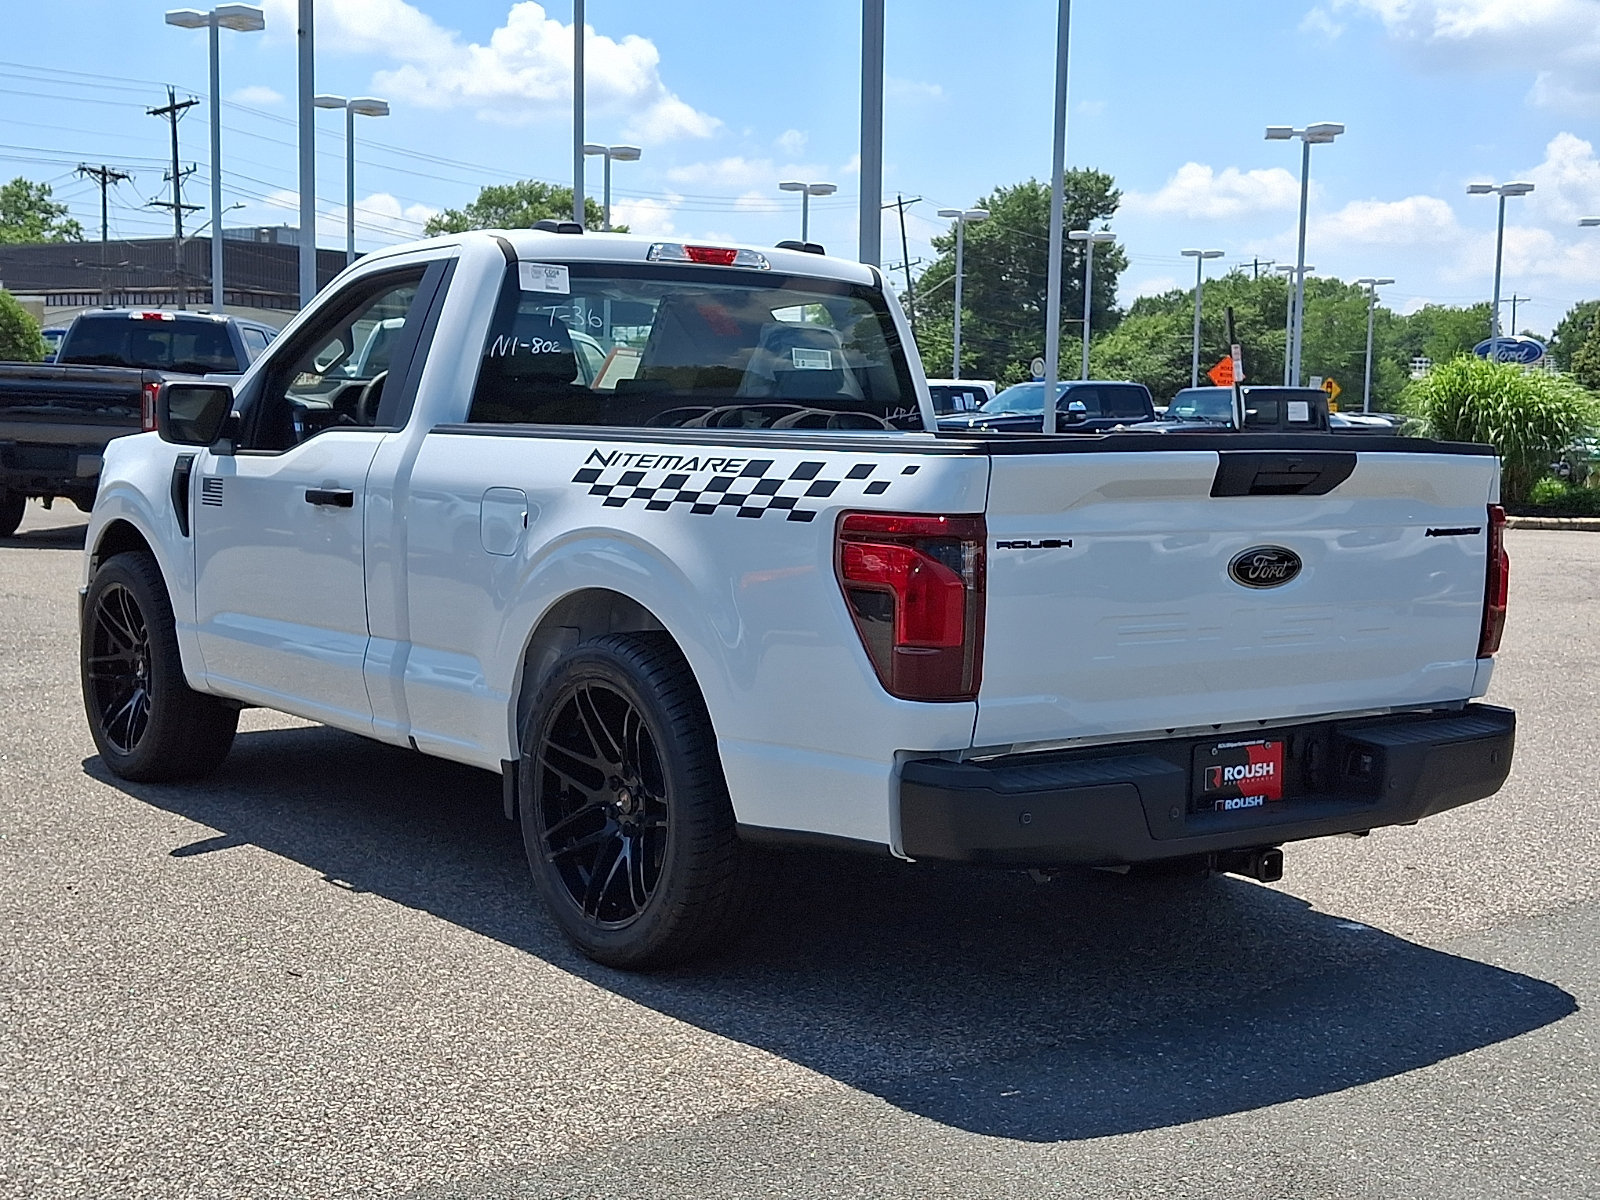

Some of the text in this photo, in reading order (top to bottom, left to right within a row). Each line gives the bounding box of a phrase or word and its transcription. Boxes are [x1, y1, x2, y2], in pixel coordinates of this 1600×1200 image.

[584, 448, 748, 473] NITEMARE
[996, 540, 1073, 549] ROUSH
[1248, 554, 1287, 579] Ford
[1224, 762, 1274, 781] ROUSH
[1225, 796, 1264, 810] ROUSH
